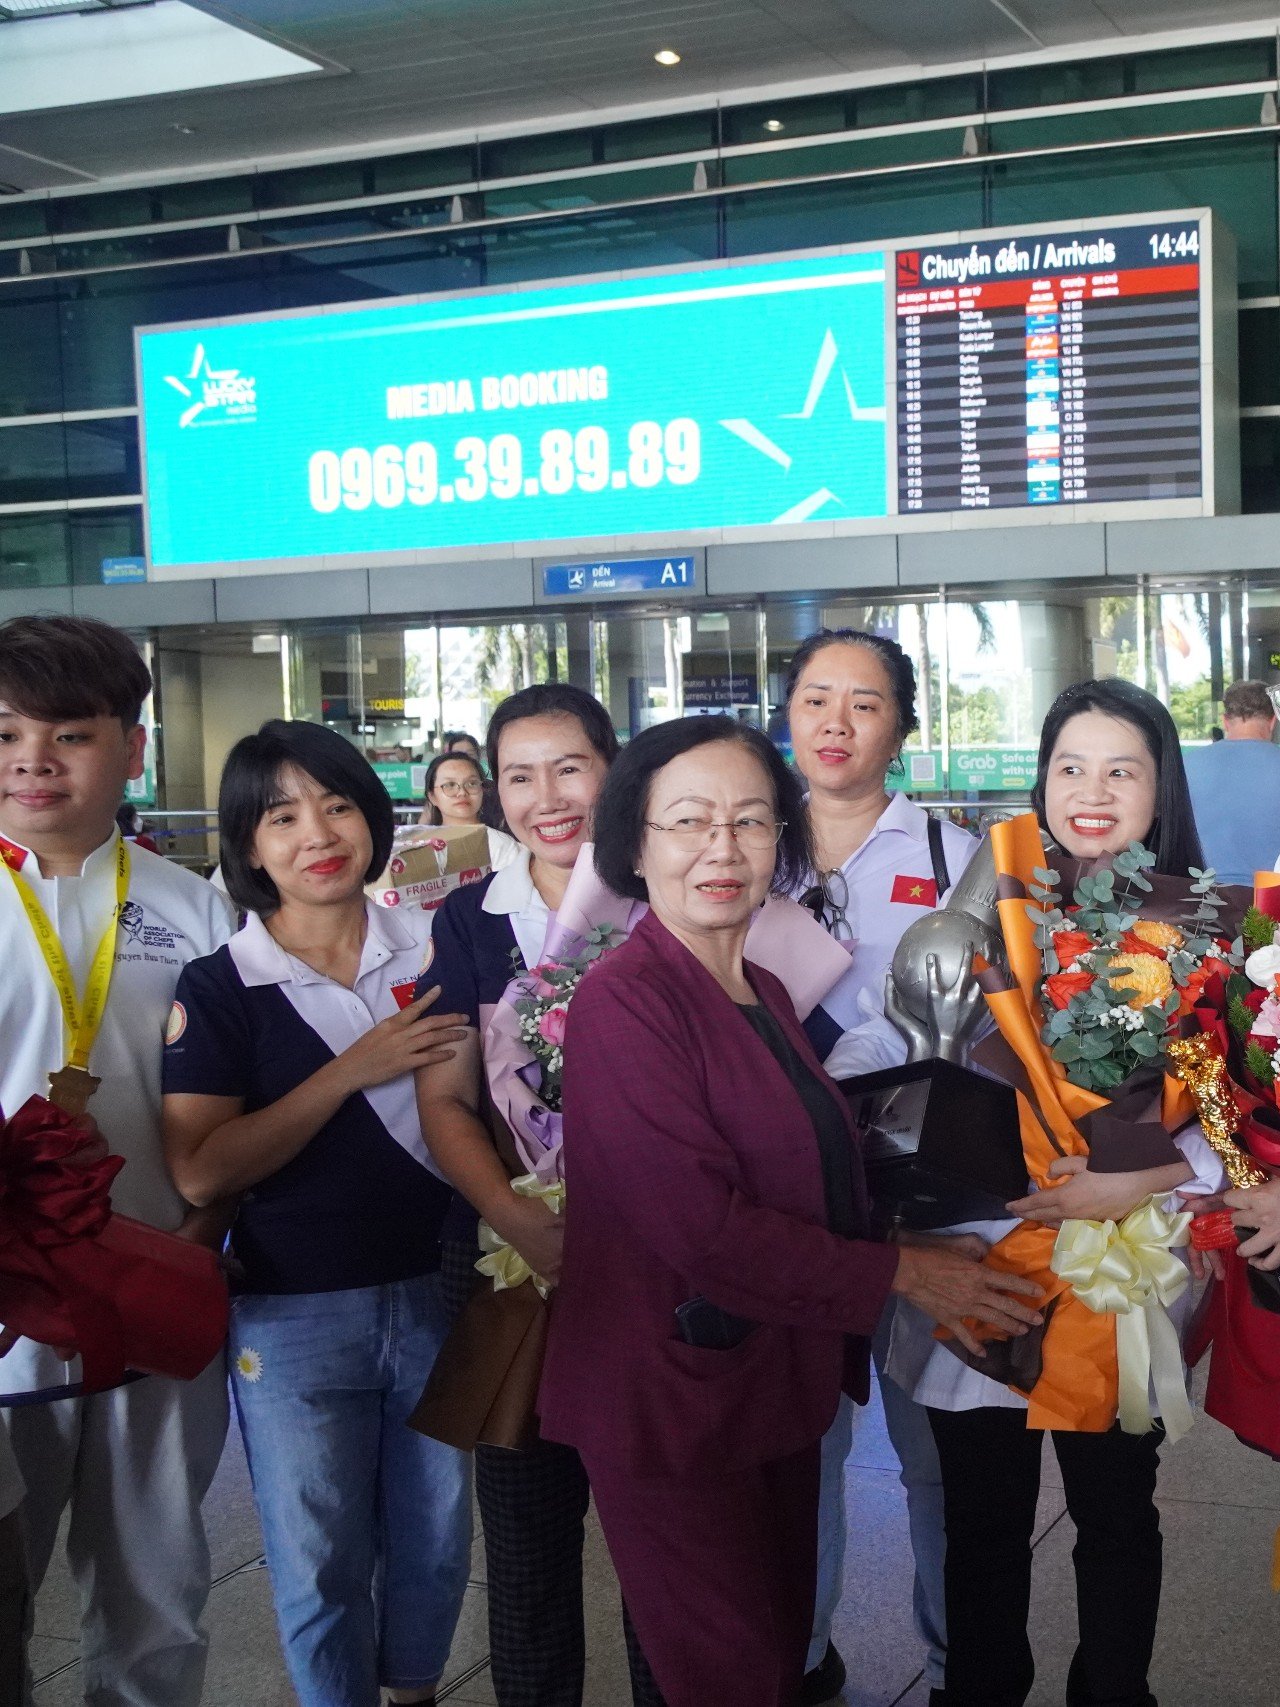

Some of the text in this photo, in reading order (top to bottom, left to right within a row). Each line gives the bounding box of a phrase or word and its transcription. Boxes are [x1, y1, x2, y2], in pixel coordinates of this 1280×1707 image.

[1032, 244, 1041, 270] /
[1043, 237, 1116, 268] Arrivals
[1148, 230, 1200, 260] 14:44
[386, 365, 609, 420] MEDIA BOOKING
[308, 417, 701, 513] 0969.39.89.89
[661, 561, 687, 585] A1
[957, 753, 997, 770] Grab
[1002, 753, 1025, 763] Safe
[1002, 765, 1024, 775] with
[406, 878, 448, 897] FRAGILE
[143, 925, 167, 933] WORLD
[389, 977, 408, 987] VIET
